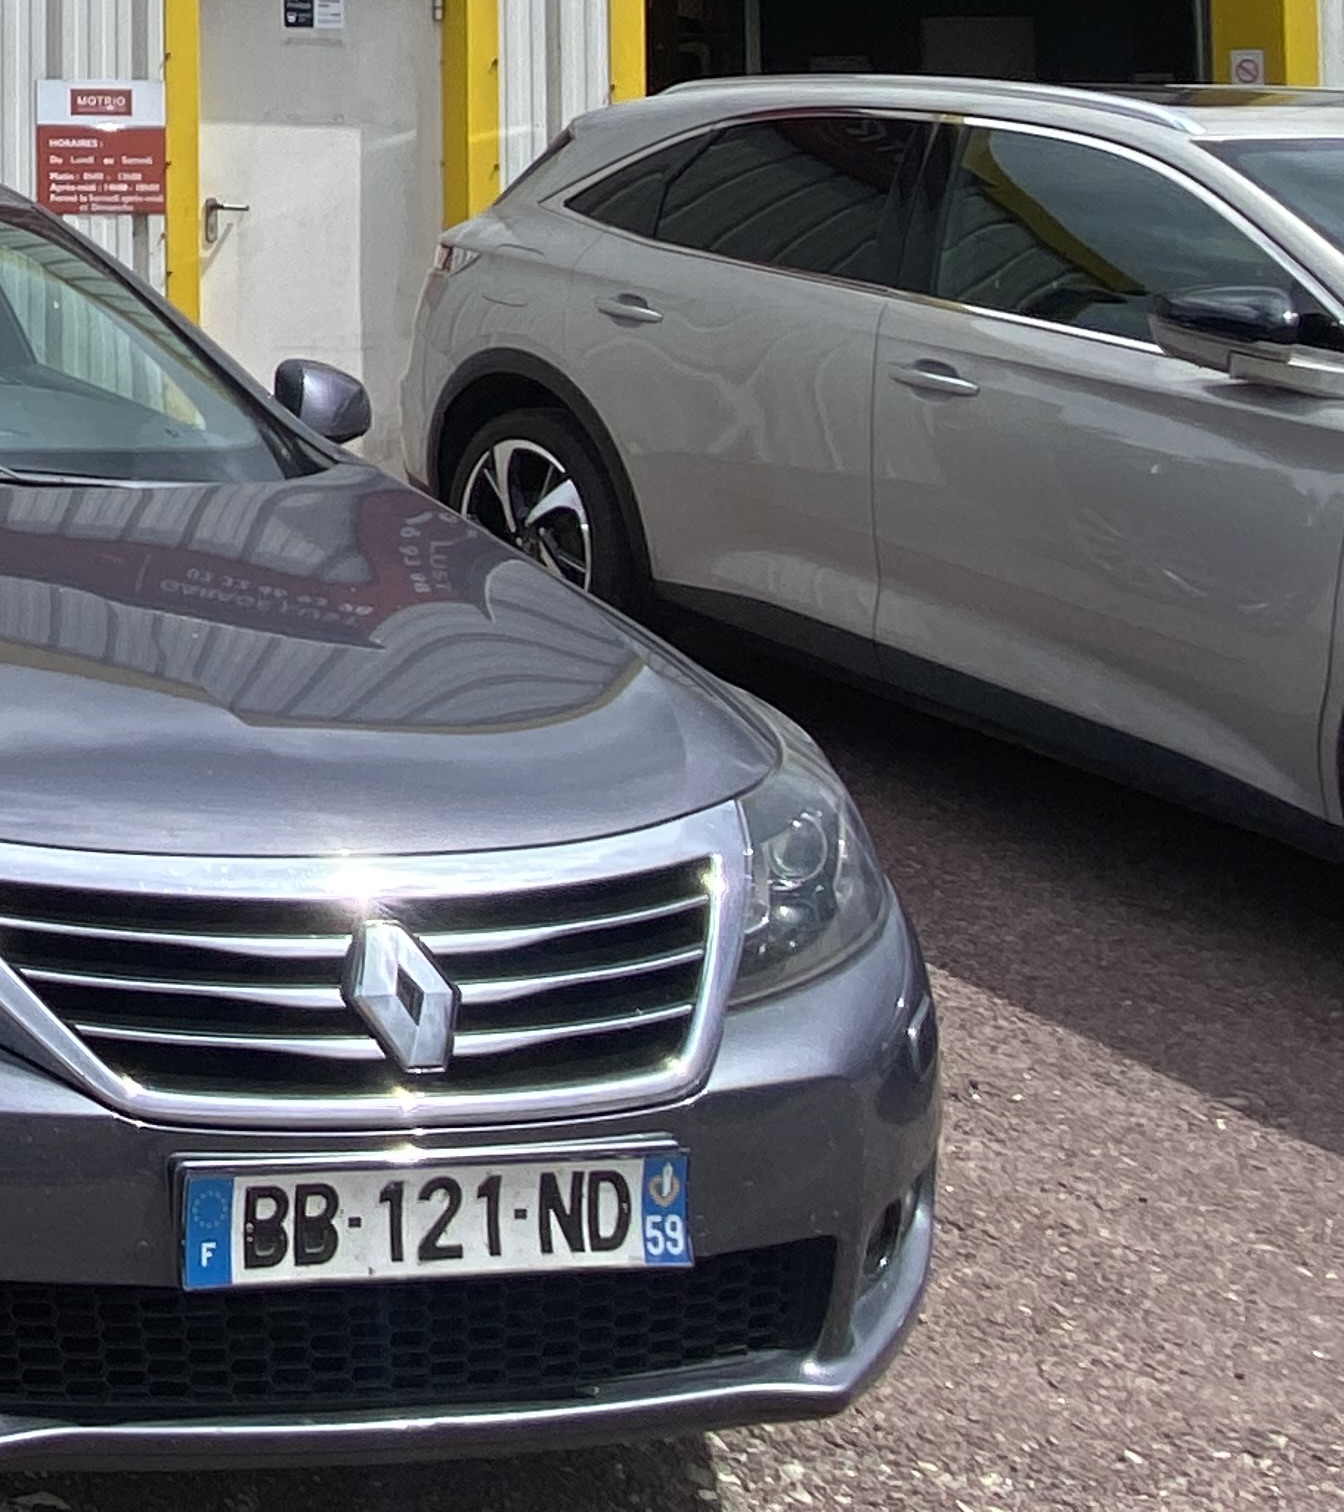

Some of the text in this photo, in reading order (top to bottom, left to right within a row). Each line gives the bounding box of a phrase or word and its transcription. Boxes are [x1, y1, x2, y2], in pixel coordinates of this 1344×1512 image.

[242, 1169, 632, 1271] BB-121-ND
[645, 1214, 685, 1256] 59
[200, 1242, 217, 1268] F
